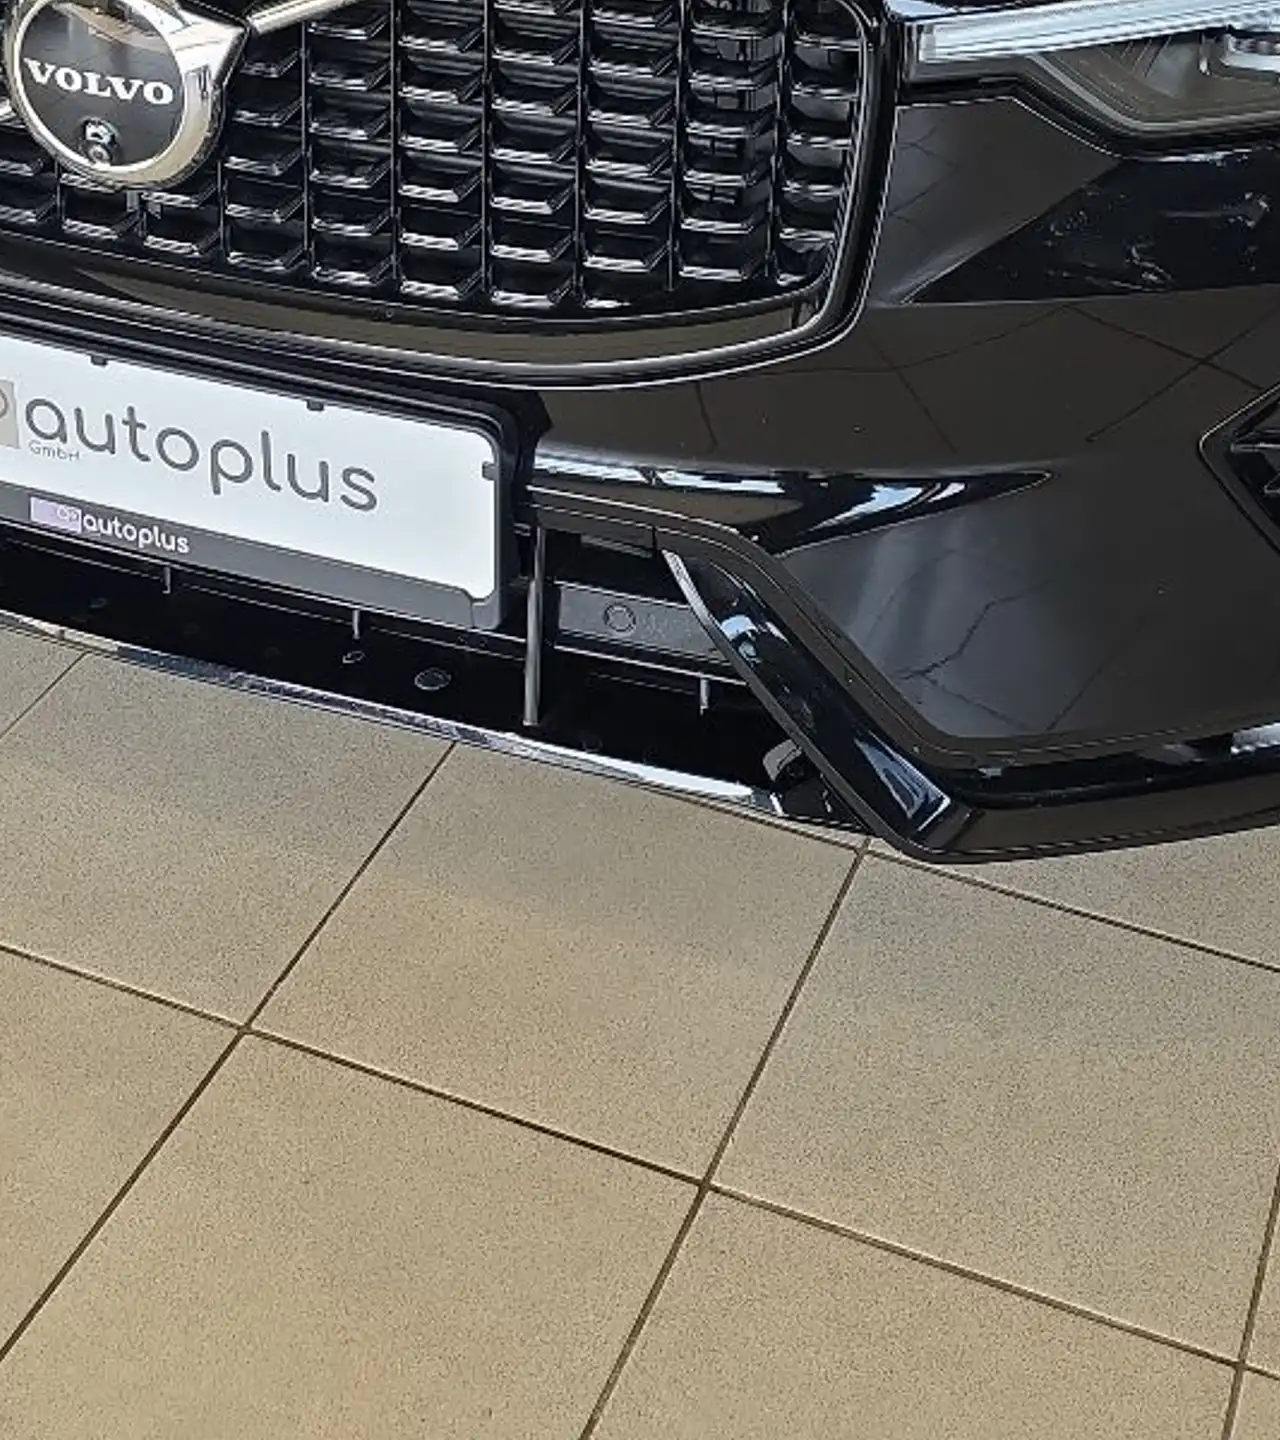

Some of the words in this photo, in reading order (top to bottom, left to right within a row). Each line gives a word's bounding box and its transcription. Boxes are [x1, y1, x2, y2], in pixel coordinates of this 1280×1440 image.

[23, 58, 174, 105] VOLVO
[25, 397, 378, 512] autoplus
[28, 439, 81, 461] GmbH
[83, 514, 190, 554] autoplus
